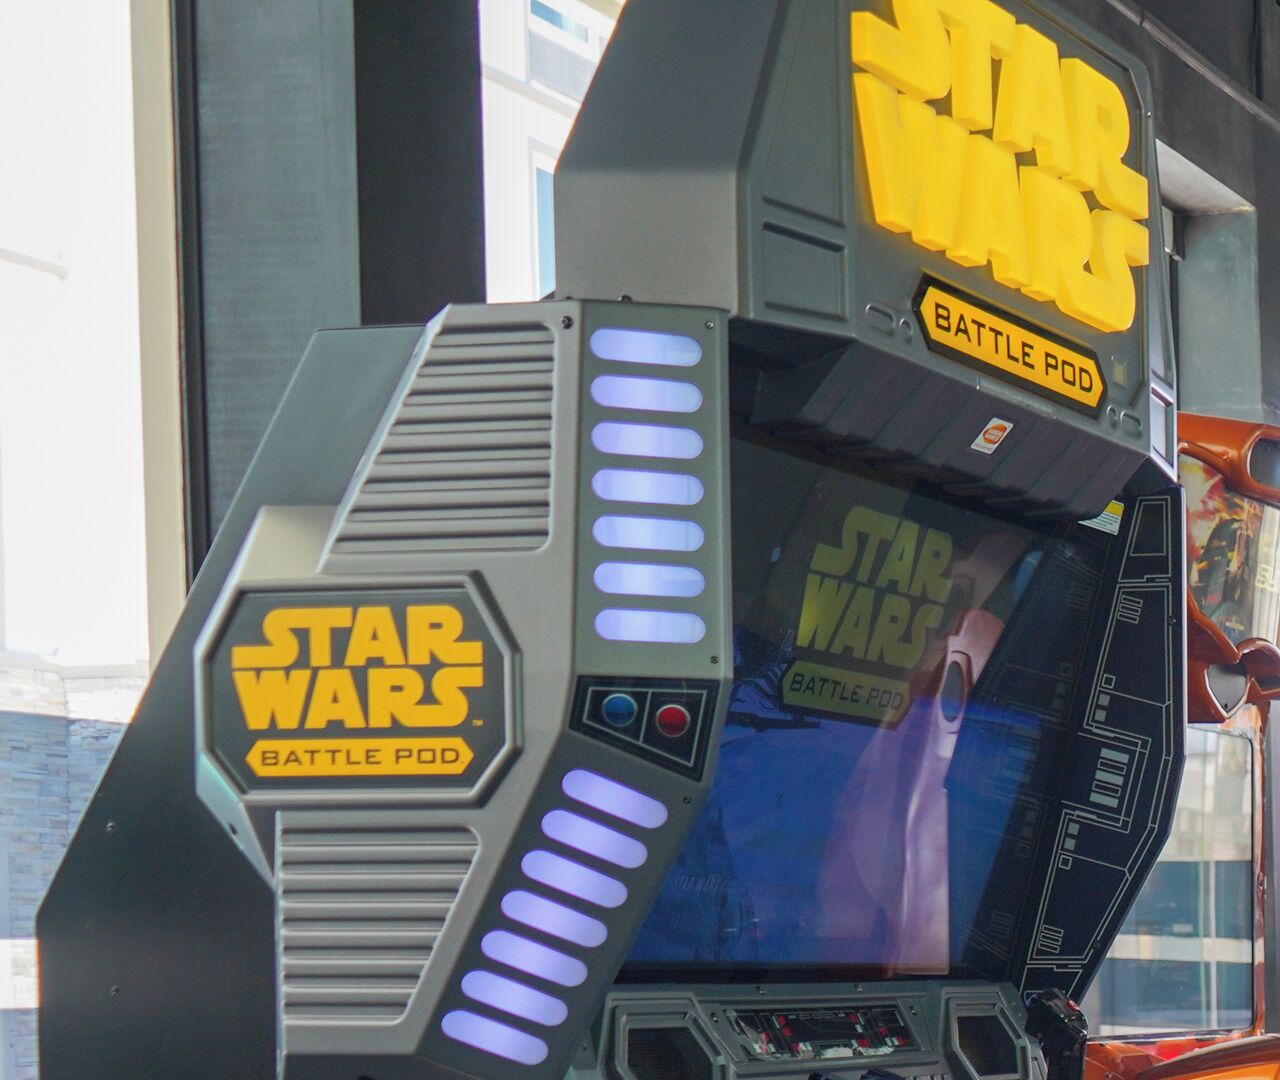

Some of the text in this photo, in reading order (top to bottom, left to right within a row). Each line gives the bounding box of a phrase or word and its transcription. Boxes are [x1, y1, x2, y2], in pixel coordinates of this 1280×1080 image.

[851, 0, 1149, 220] STAR
[853, 72, 1150, 333] WARS
[934, 301, 1094, 394] BATTLE POD
[810, 505, 955, 605] STAR
[231, 604, 484, 669] STAR
[796, 572, 946, 670] WARS
[231, 665, 485, 731] WARS
[789, 672, 905, 711] BATTLE POD
[260, 747, 460, 767] BATTLE POD
